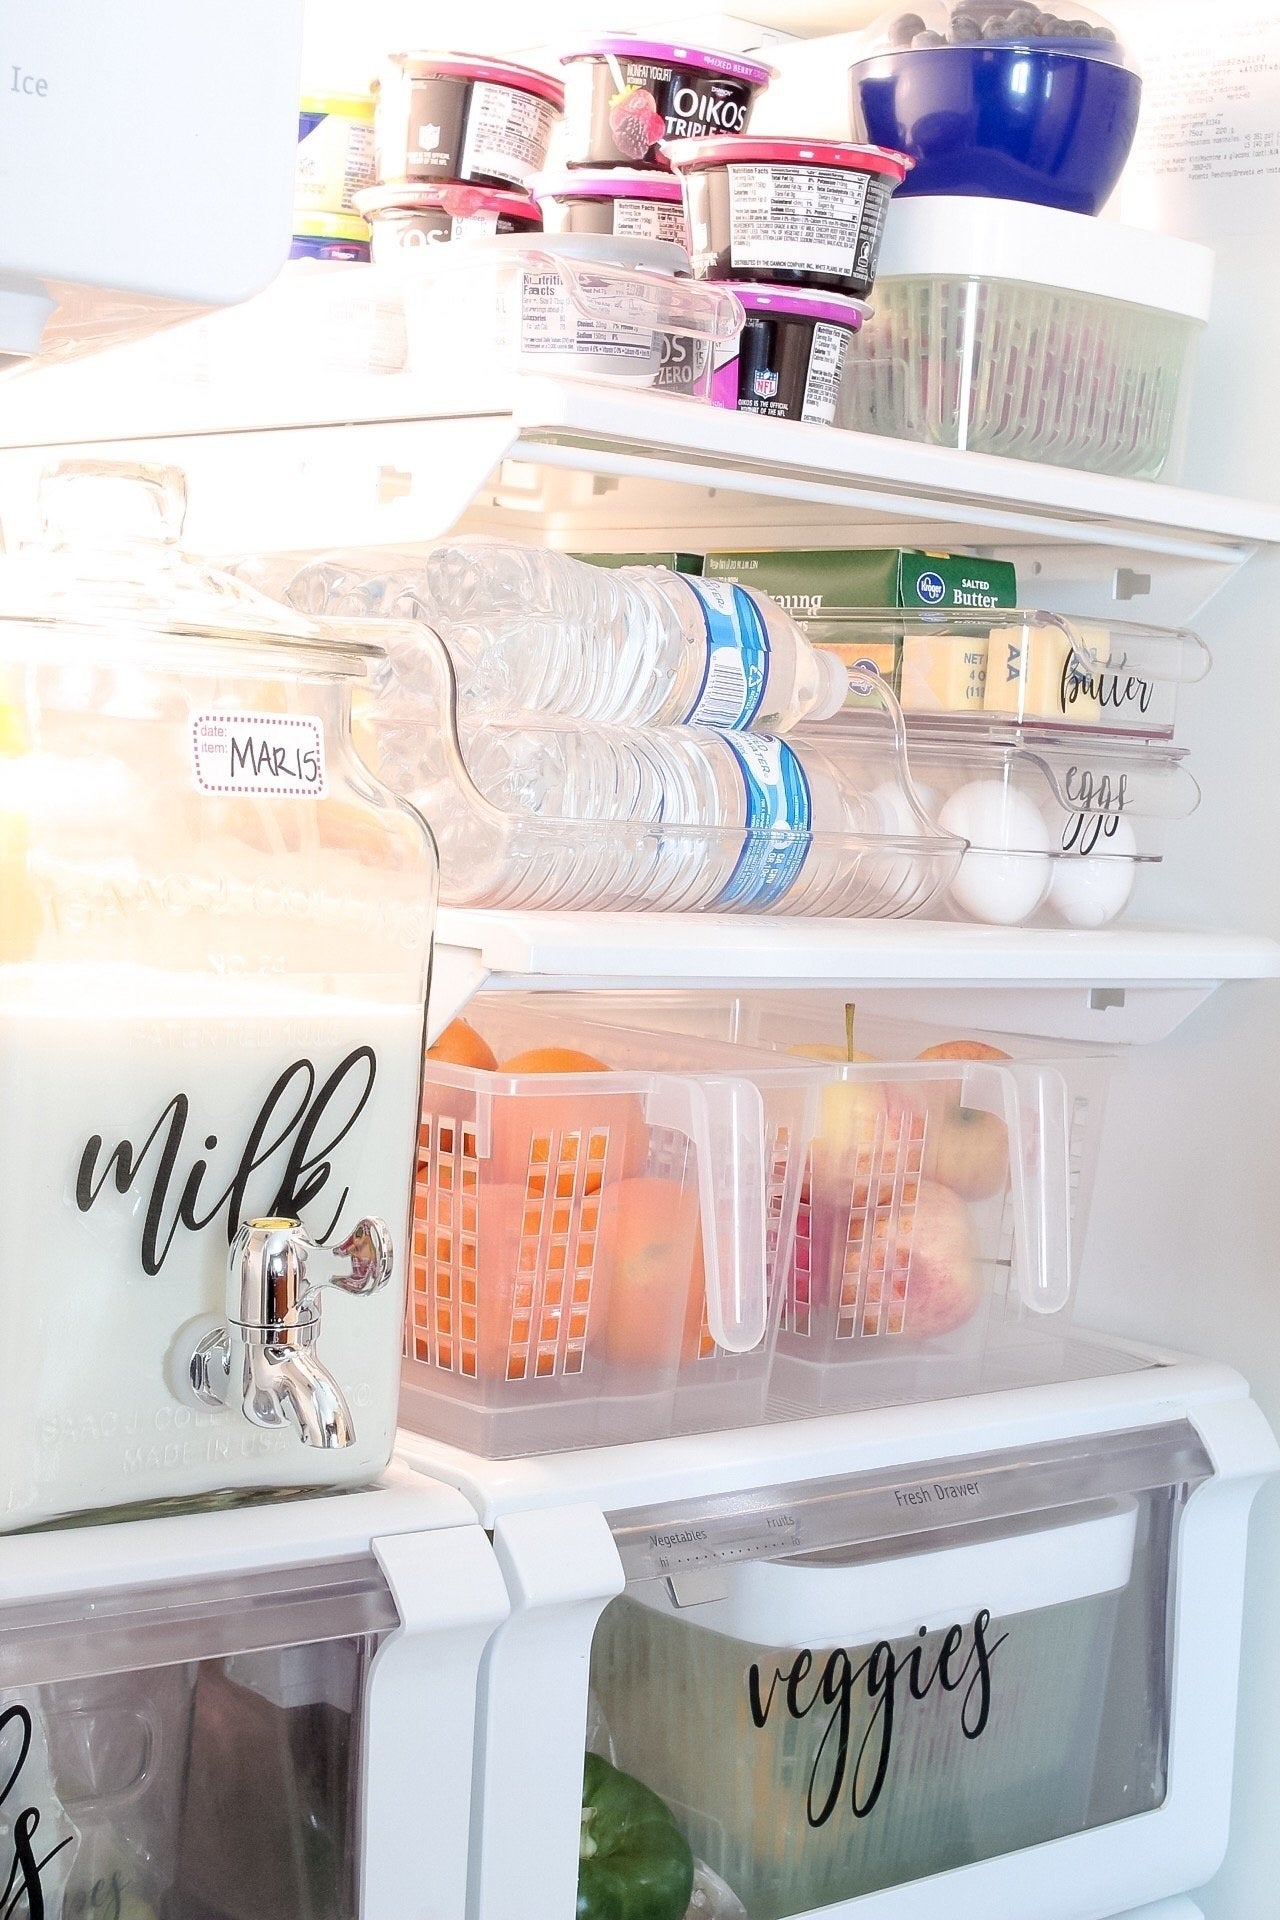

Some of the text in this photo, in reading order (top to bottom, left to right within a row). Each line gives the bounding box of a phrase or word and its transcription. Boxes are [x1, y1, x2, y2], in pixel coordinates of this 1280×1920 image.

[11, 65, 48, 97] Ice
[627, 64, 672, 82] NONFAT YOGURT
[673, 88, 747, 131] OIKOS
[659, 365, 692, 385] ZERO
[757, 380, 775, 393] NFL
[738, 399, 753, 407] OIKOS
[770, 402, 789, 410] OFFICIAL
[921, 577, 942, 599] Kroger
[962, 578, 990, 590] SALTED
[953, 589, 998, 609] Butter
[964, 652, 985, 665] NET
[969, 671, 975, 681] 4
[200, 725, 228, 738] date:
[201, 742, 228, 754] item:
[1062, 766, 1134, 856] eggs
[766, 853, 777, 863] OR
[766, 853, 785, 884] CA CRV
[205, 1436, 232, 1462] IN
[895, 1480, 981, 1507] Fresh Drawer
[766, 1514, 796, 1530] Fruits
[650, 1527, 708, 1549] Vegetables
[660, 1555, 670, 1569] hi
[747, 1607, 1010, 1829] veggies
